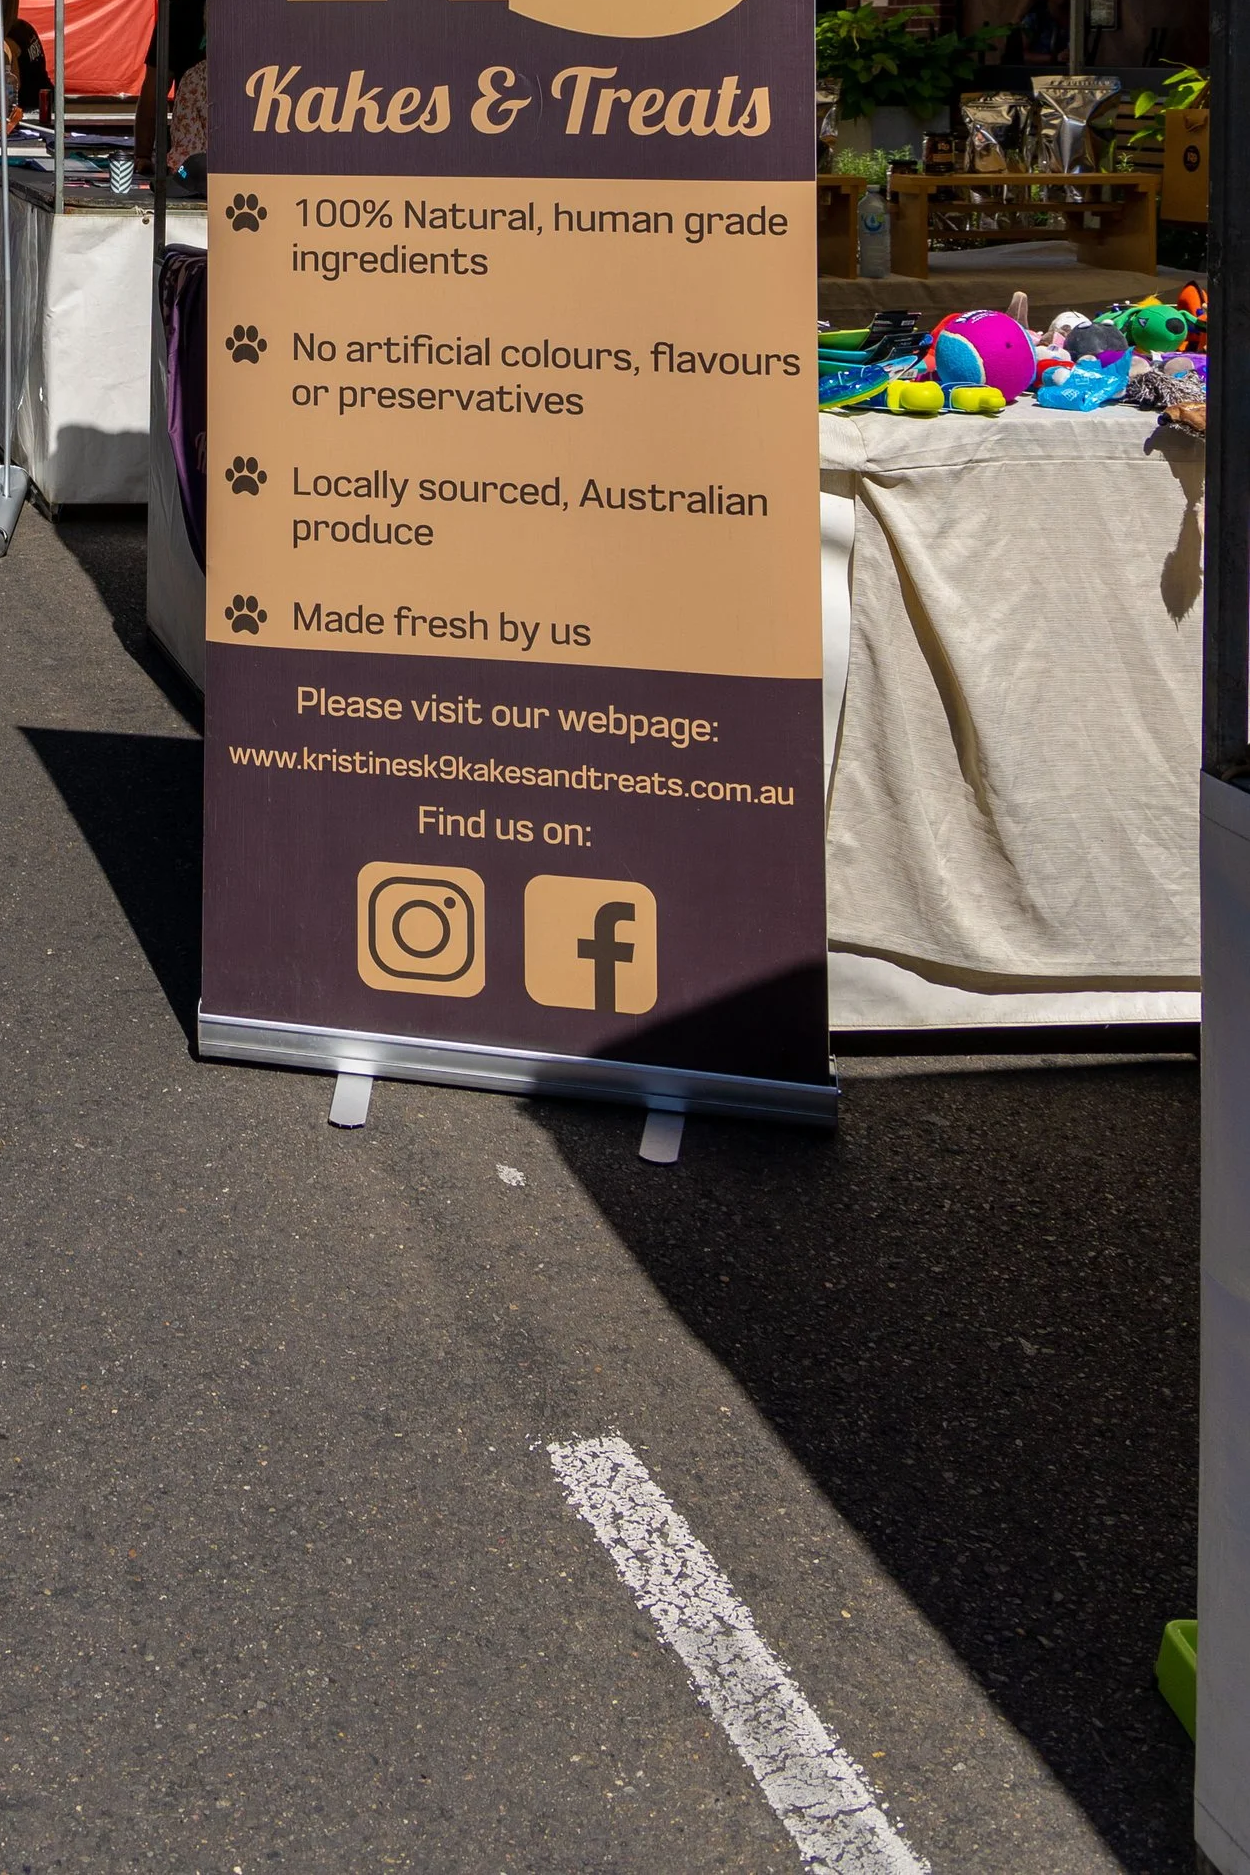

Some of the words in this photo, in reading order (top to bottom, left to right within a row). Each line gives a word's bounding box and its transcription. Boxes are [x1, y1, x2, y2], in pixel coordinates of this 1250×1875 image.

[246, 66, 450, 133] Kakes
[471, 66, 532, 134] &
[552, 67, 770, 136] Treats
[296, 199, 392, 228] 100%
[405, 201, 542, 235] Natural,
[555, 203, 672, 233] human
[685, 206, 787, 243] grade
[293, 243, 488, 281] ingredients
[294, 333, 336, 361] No
[347, 335, 489, 365] artificial
[502, 339, 639, 376] colours,
[651, 342, 800, 375] flavours
[293, 385, 329, 406] or
[340, 384, 583, 415] preservatives
[294, 467, 409, 507] Locally
[419, 477, 568, 511] sourced,
[579, 479, 767, 516] Australian
[294, 515, 433, 548] produce
[294, 602, 384, 634] Made
[394, 606, 488, 640] fresh
[500, 612, 540, 651] by
[552, 623, 591, 646] us
[298, 687, 402, 719] Please
[411, 694, 482, 724] visit
[492, 706, 549, 728] our
[558, 706, 718, 748] webpage:
[229, 745, 794, 806] www.kristinesk9kakesandtreats.com.au
[420, 806, 485, 838] Find
[496, 819, 533, 841] us
[544, 823, 591, 846] on:
